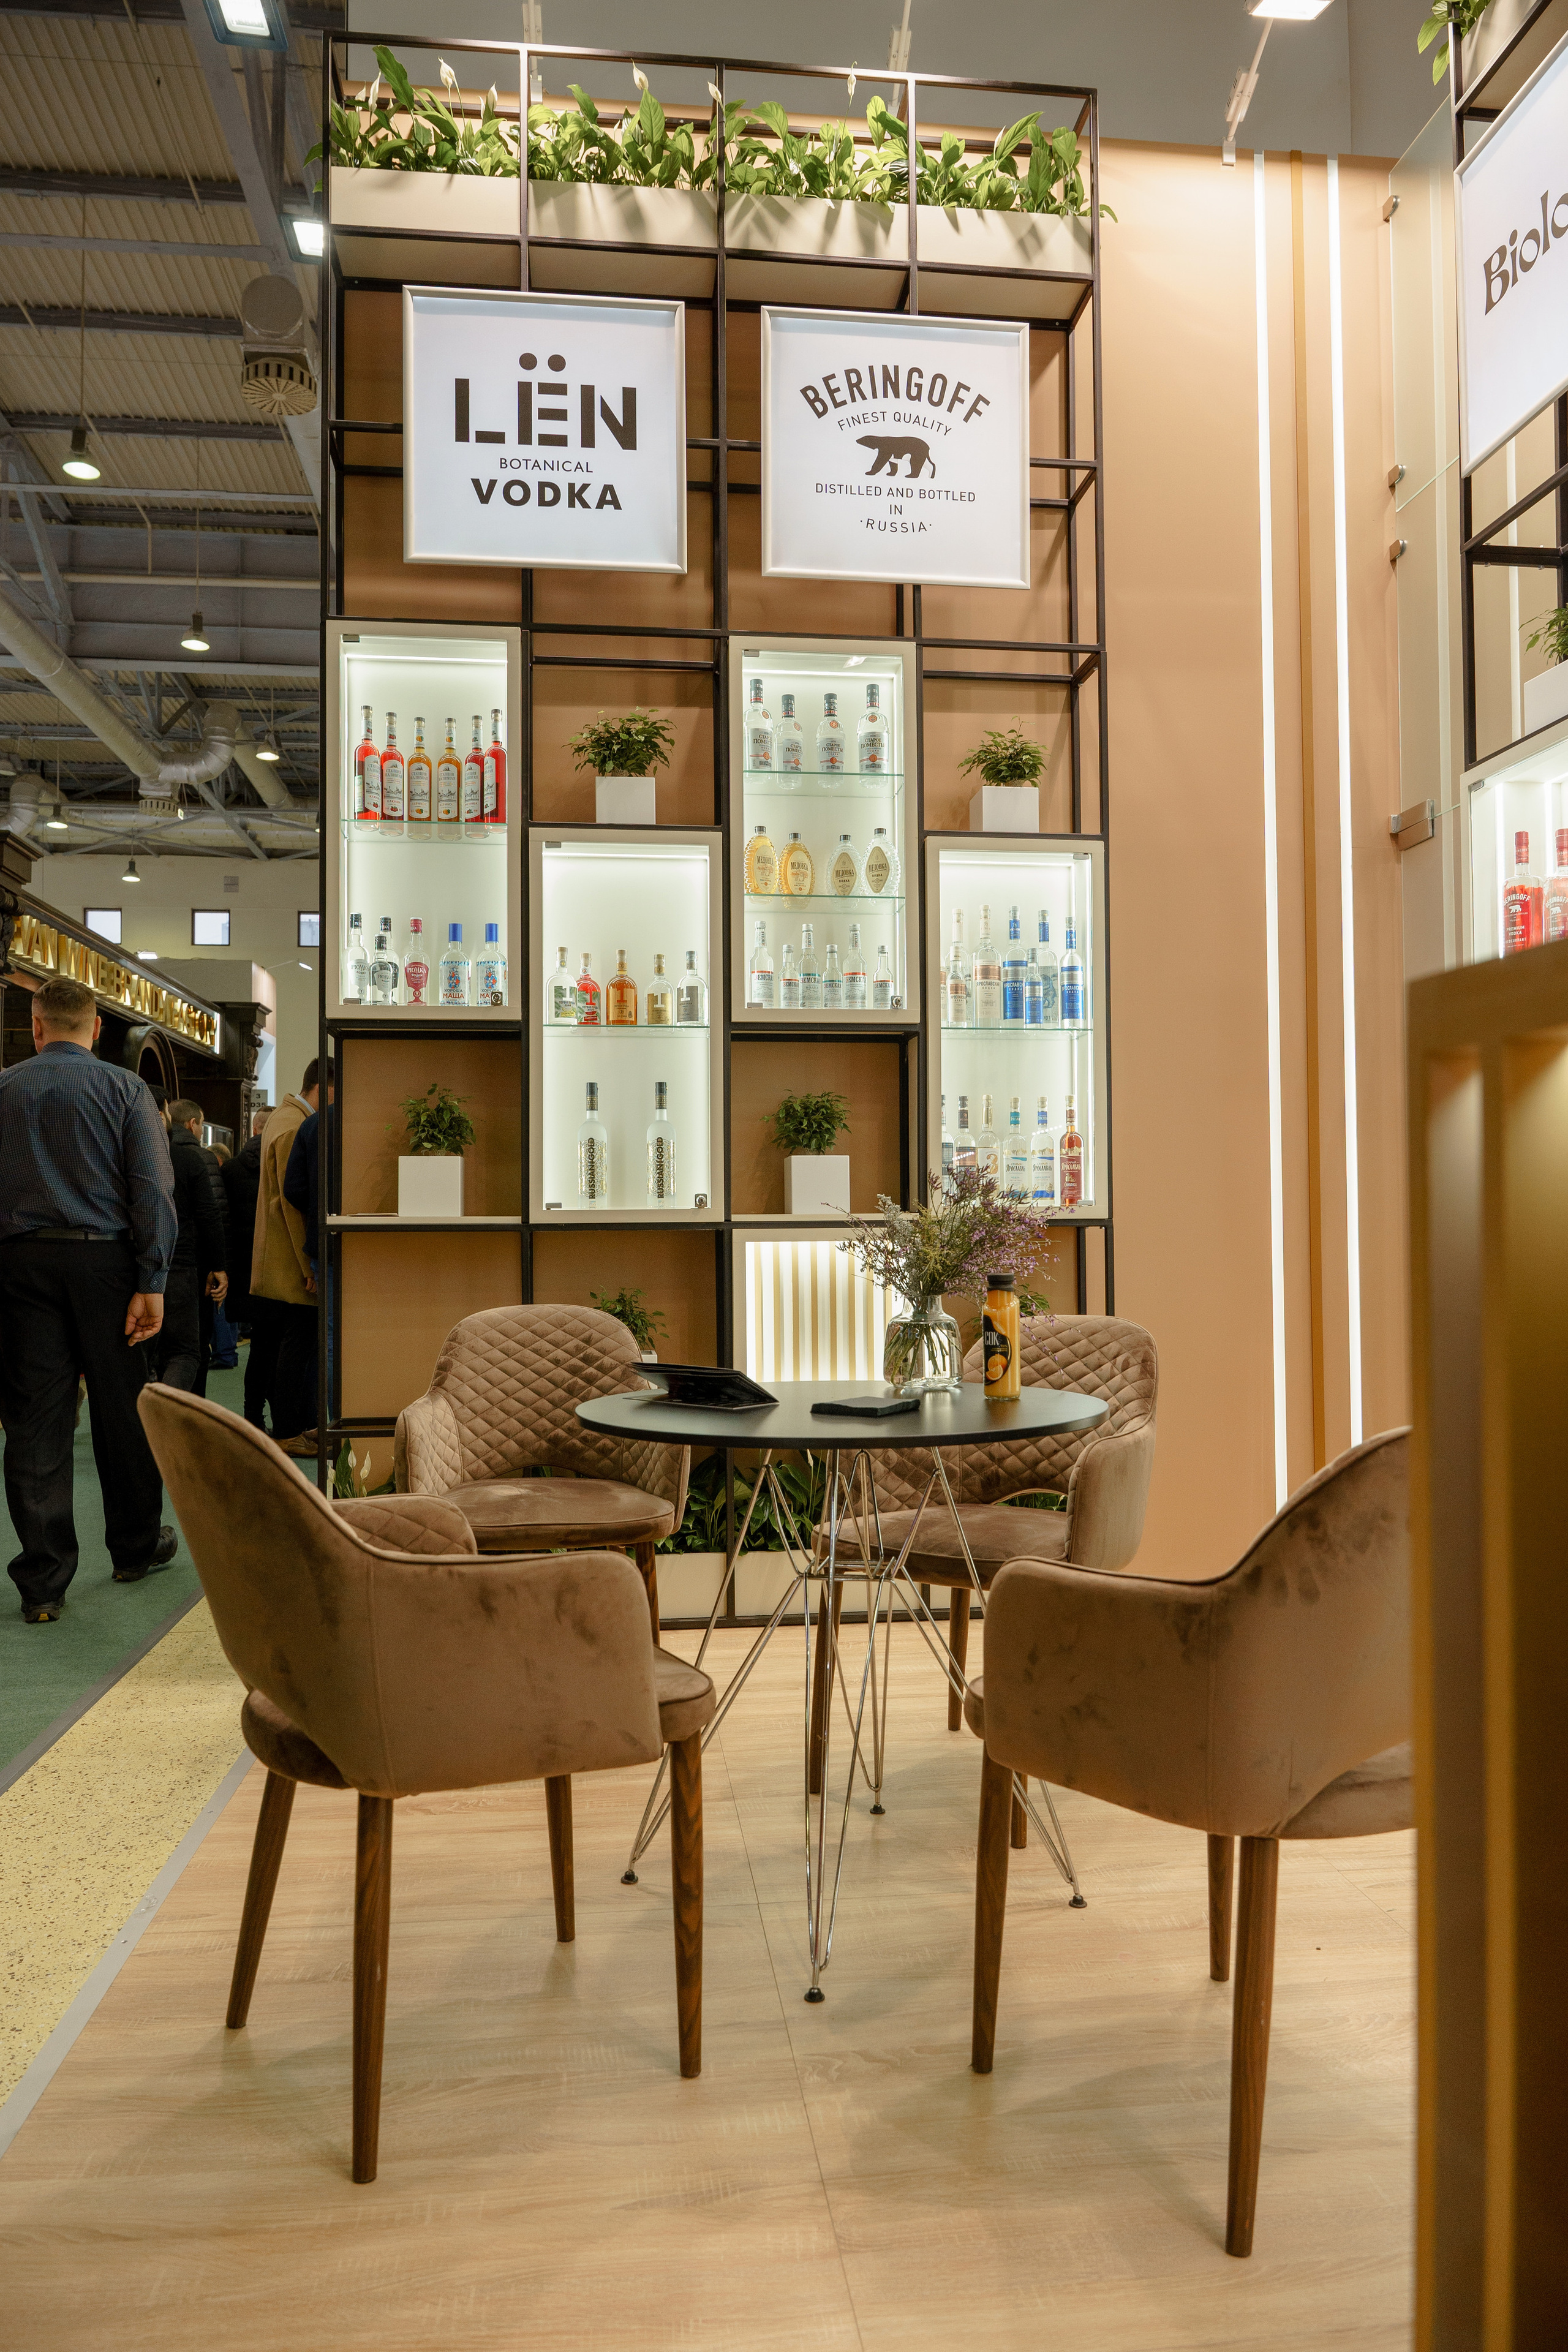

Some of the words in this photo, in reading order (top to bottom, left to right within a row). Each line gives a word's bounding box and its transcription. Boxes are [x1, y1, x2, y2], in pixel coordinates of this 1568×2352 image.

[799, 364, 990, 423] BERINGOFF
[455, 353, 637, 450] LËN
[837, 411, 888, 431] FINEST
[893, 411, 952, 436] QUALITY
[500, 458, 593, 473] BOTANICAL
[470, 478, 622, 510] VODKA
[816, 483, 881, 497] DISTILLED
[887, 487, 913, 498] AND
[919, 489, 976, 502] BOTTLED
[889, 504, 903, 515] IN
[757, 856, 774, 866] МЕДОВКА
[790, 862, 809, 871] МЕДОВКА
[869, 863, 887, 873] МЕДОВКА
[835, 869, 854, 878] МЕДОВКА
[58, 933, 108, 994] WINE
[107, 961, 168, 1022] BRANDY
[984, 1331, 999, 1346] СОК
